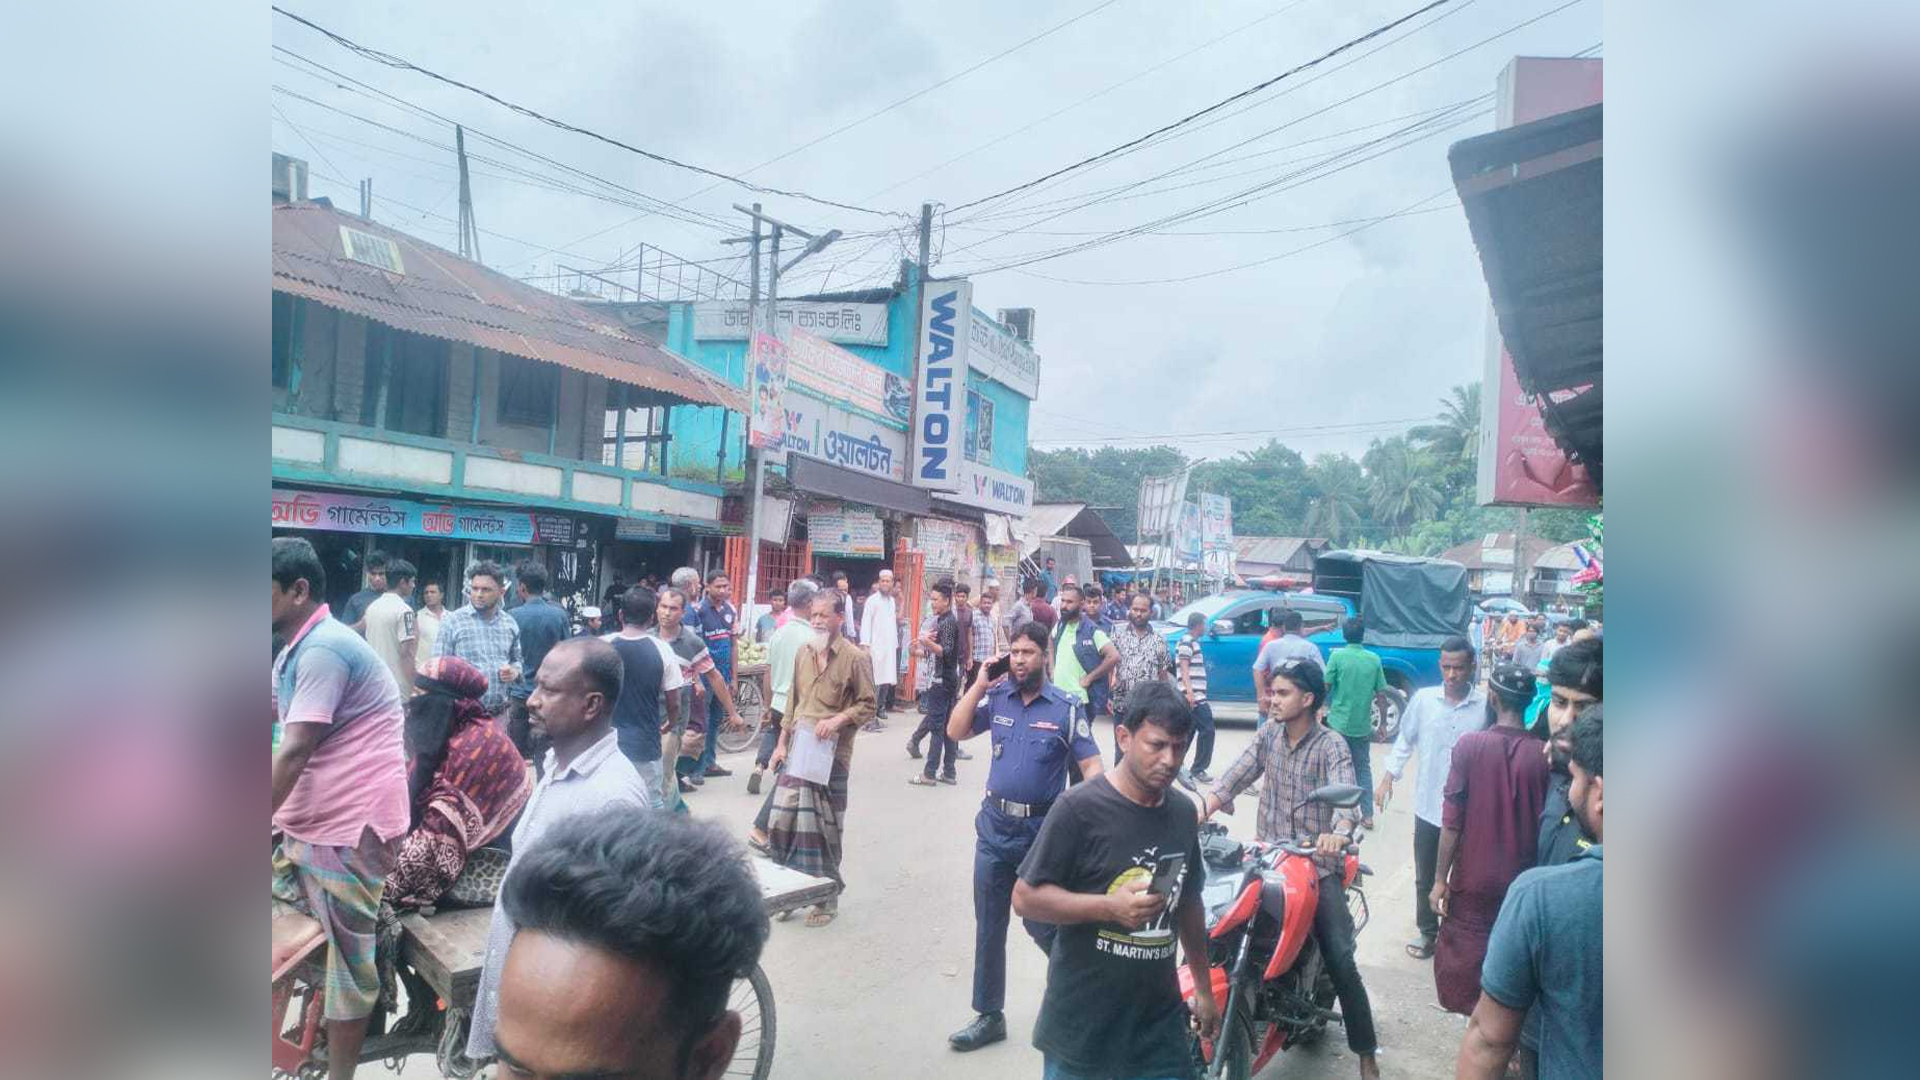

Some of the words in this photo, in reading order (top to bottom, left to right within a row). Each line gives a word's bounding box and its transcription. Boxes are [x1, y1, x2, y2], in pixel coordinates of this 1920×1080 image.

[921, 290, 958, 480] WALTON
[781, 431, 810, 453] ALTON
[824, 431, 892, 474] ওয়ালটন
[992, 480, 1025, 505] WALTON
[1096, 939, 1110, 953] ST.
[1113, 943, 1160, 960] MARTIN'S
